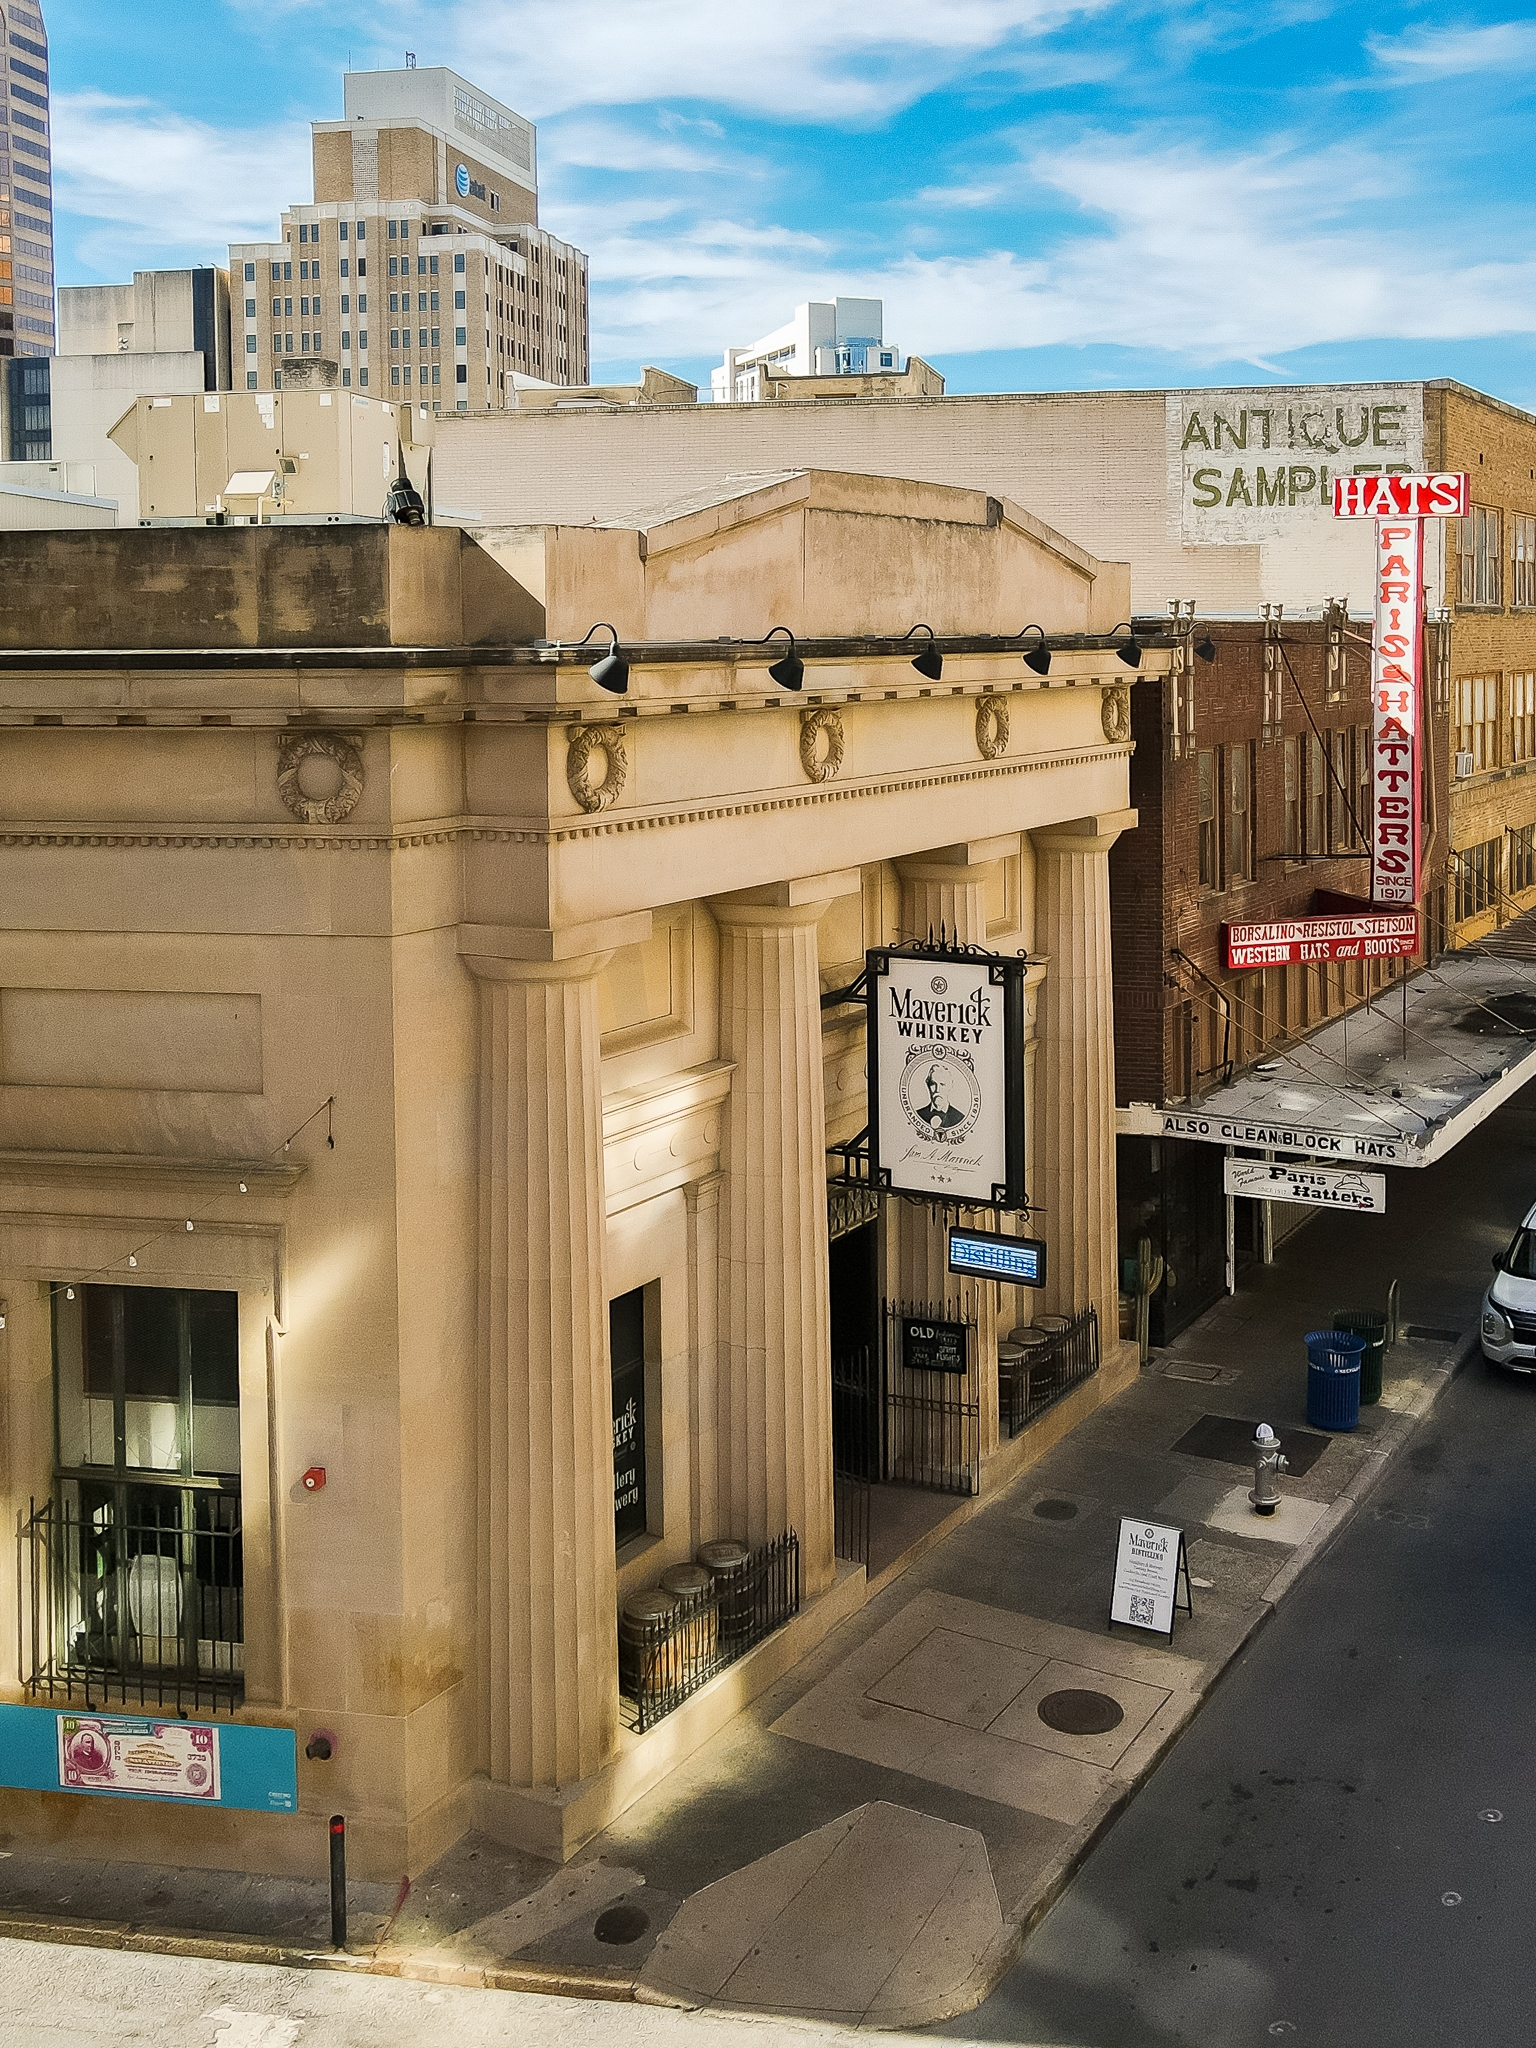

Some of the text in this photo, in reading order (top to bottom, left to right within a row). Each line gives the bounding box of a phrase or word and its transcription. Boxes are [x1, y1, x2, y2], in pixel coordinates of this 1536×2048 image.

[1181, 405, 1408, 454] ANTIQUE
[1337, 477, 1459, 515] HATS
[1378, 527, 1412, 658] PARIS
[1377, 690, 1410, 873] HATTERS
[1376, 876, 1411, 887] SINCE
[1380, 888, 1407, 899] 1917
[1232, 916, 1414, 943] BORSALINO RESISTOL STETSON
[1231, 937, 1400, 965] WESTERN HATS and BOOTS
[888, 986, 992, 1027] Maverick
[897, 1020, 983, 1044] WHISKEY
[901, 1087, 931, 1134] UNBRANDED
[951, 1122, 972, 1137] SINCE
[1164, 1117, 1210, 1135] ALSO
[1221, 1125, 1278, 1144] CLEAN
[1283, 1131, 1341, 1151] BLOCK
[1355, 1140, 1396, 1158] HATS
[1268, 1166, 1327, 1186] Paris
[1292, 1185, 1375, 1209] Hatters
[910, 1326, 934, 1339] OLD
[66, 1720, 75, 1730] 10
[195, 1734, 208, 1745] 10
